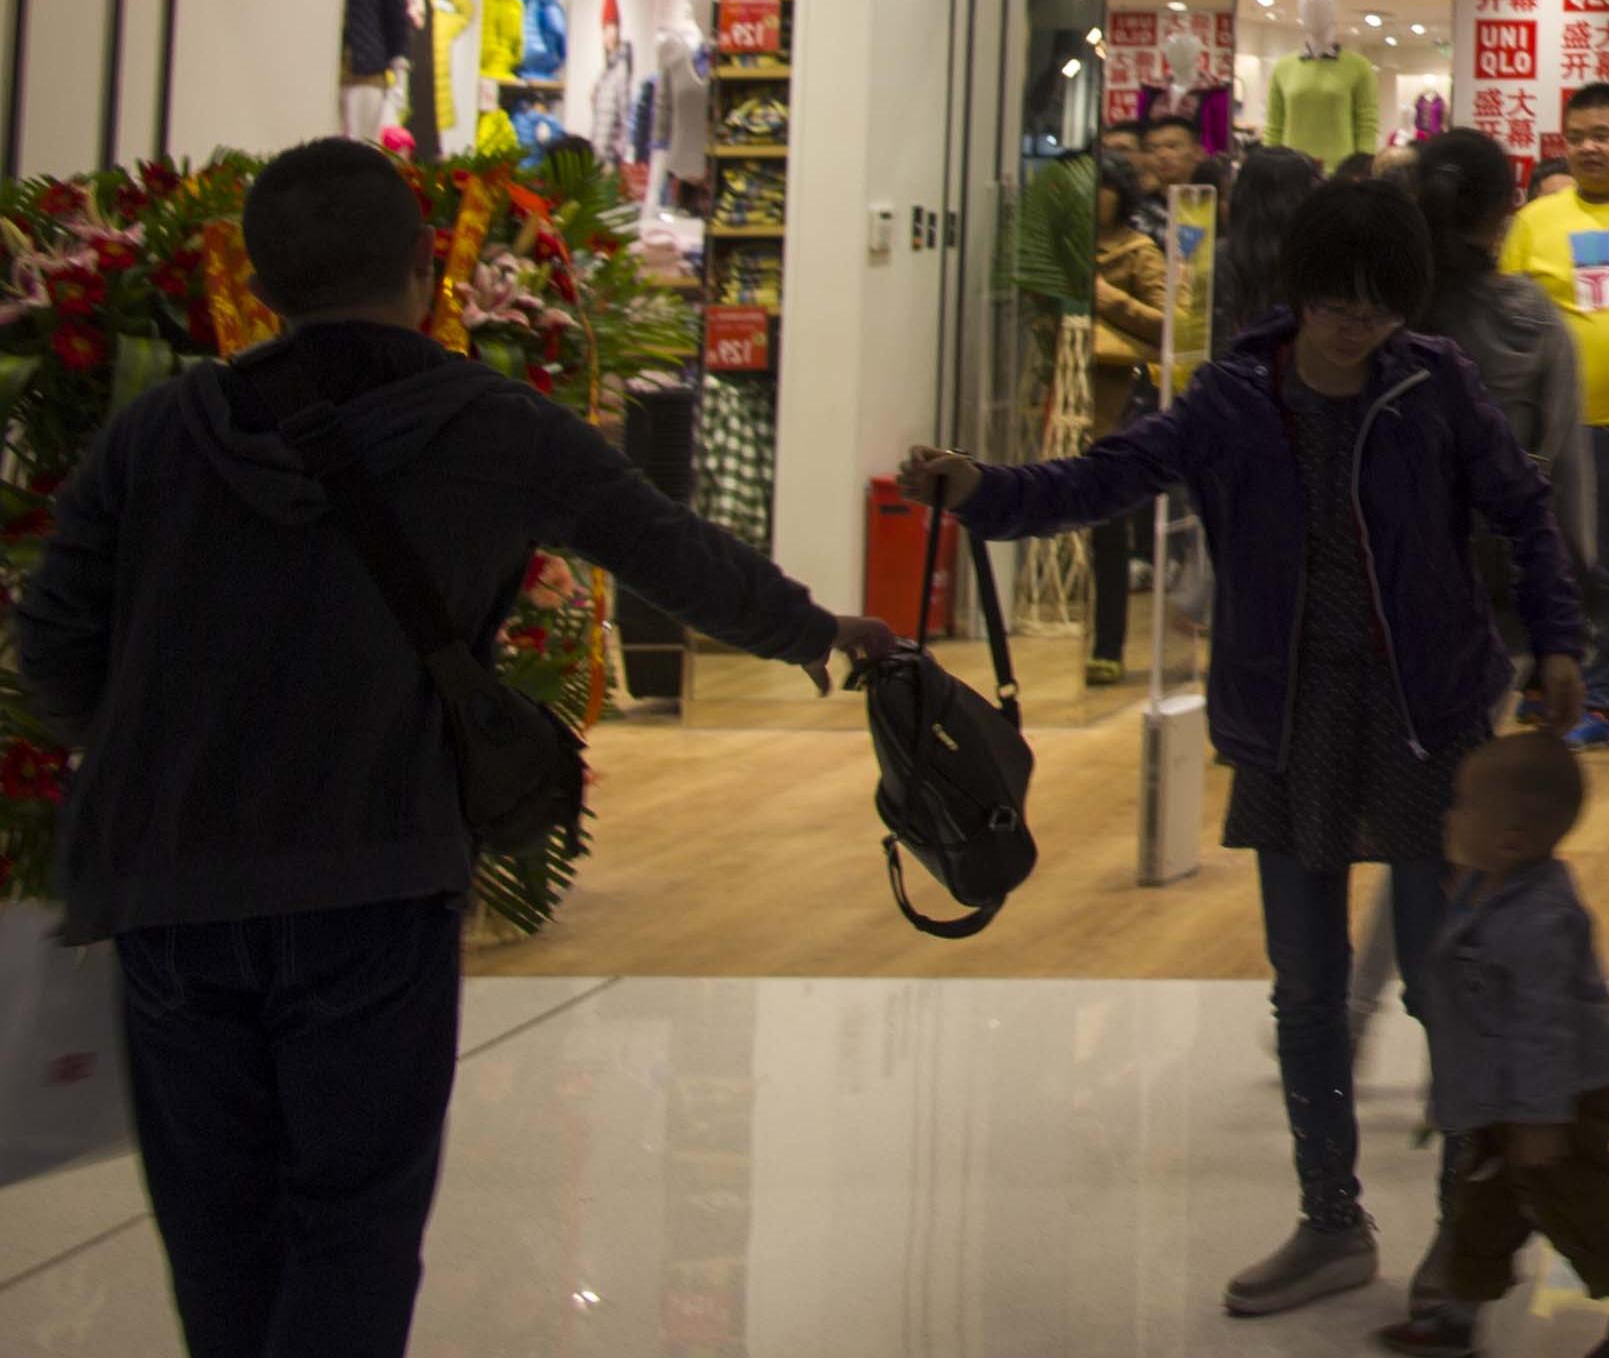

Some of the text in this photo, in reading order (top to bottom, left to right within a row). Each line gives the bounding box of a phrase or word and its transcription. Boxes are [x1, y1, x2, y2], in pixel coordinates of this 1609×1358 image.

[1480, 25, 1529, 48] UNI
[1480, 50, 1532, 77] QLO
[1473, 88, 1537, 117] 盛大
